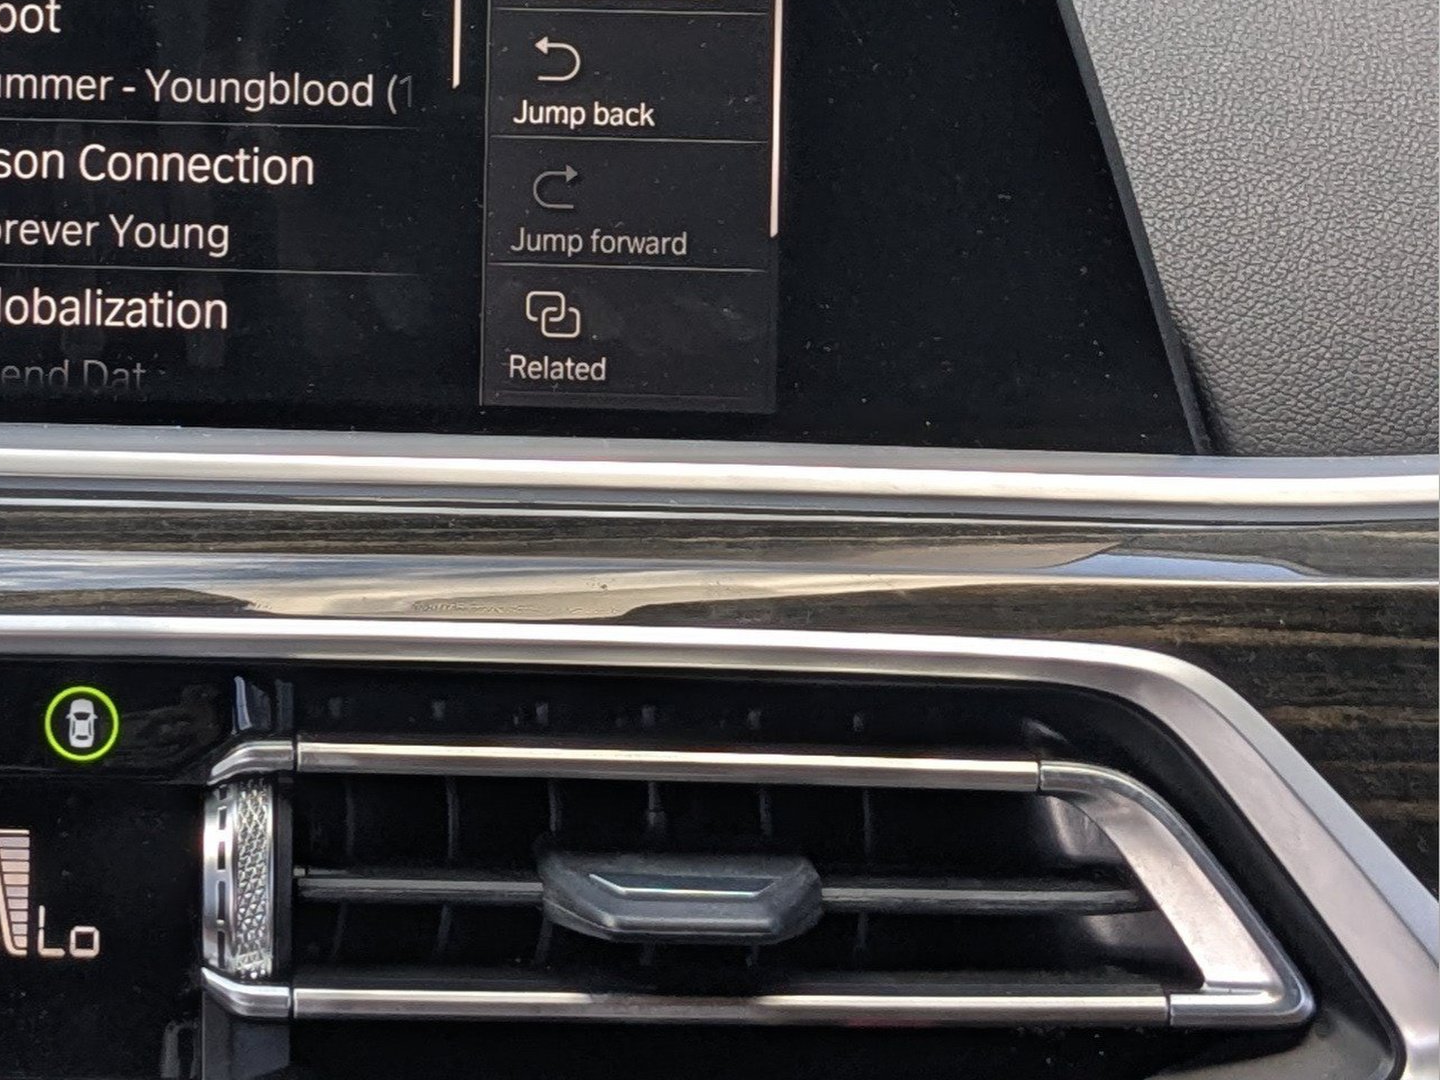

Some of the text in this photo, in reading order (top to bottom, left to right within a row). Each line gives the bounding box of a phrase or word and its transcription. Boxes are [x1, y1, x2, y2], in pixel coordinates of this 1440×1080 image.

[145, 69, 375, 113] Youngblood
[513, 100, 656, 130] Jump back
[79, 143, 315, 186] Connection
[109, 214, 231, 258] Young
[510, 228, 688, 257] Jump forward
[509, 354, 607, 382] Related
[37, 905, 101, 959] Lo
